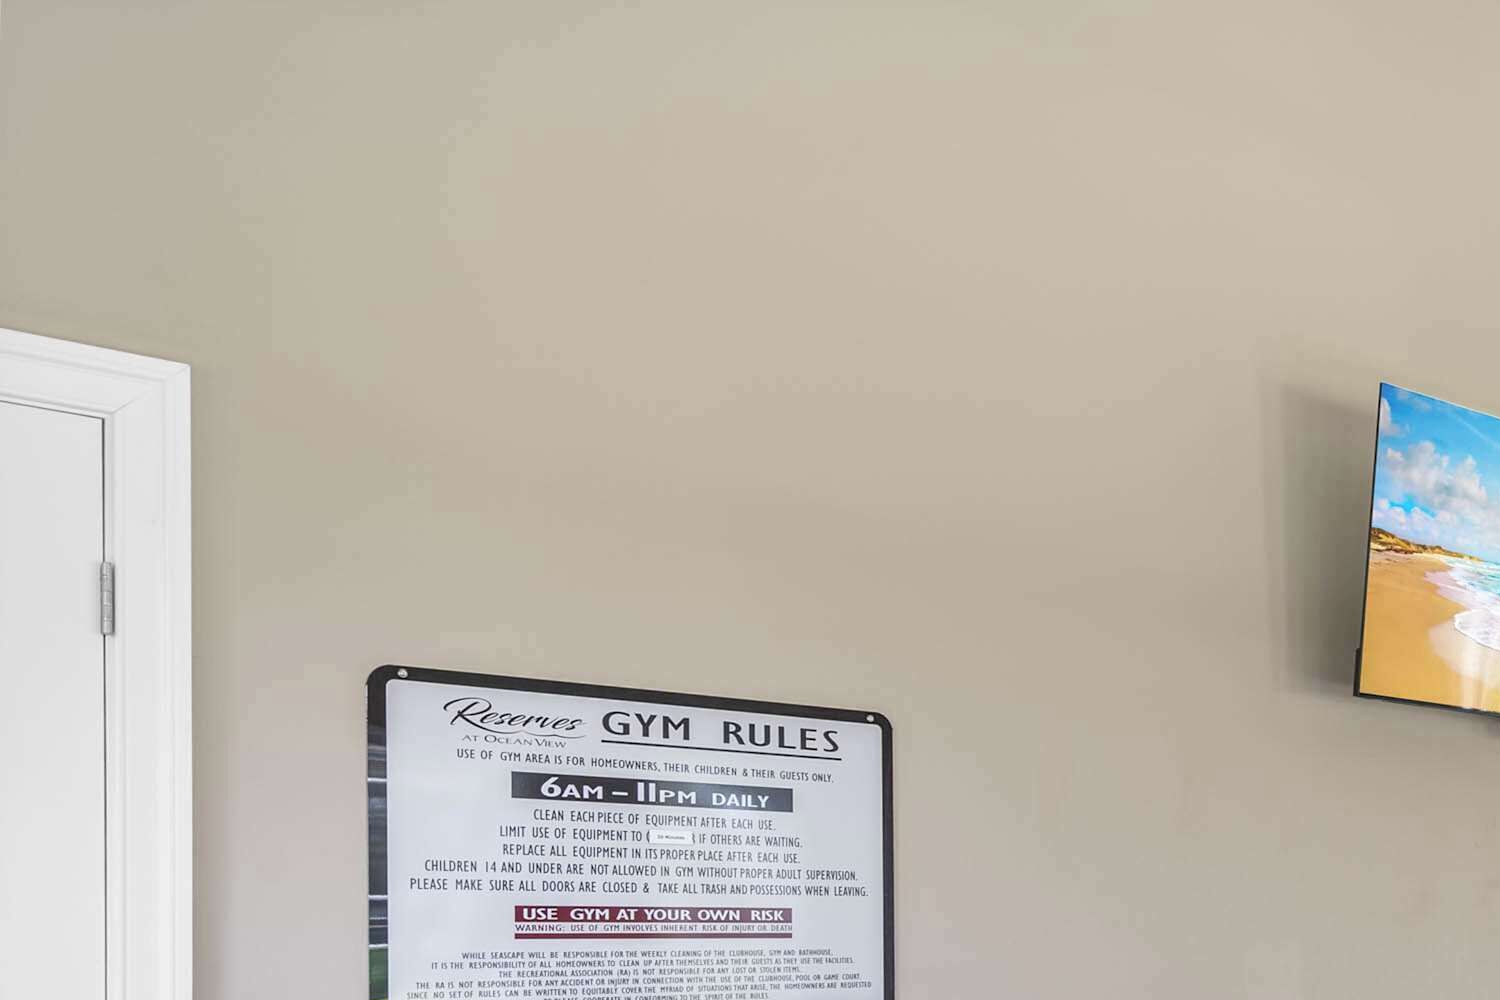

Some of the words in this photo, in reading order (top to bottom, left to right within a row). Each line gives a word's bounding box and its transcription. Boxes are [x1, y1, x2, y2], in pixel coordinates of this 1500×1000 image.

[443, 696, 586, 739] Reserves
[462, 734, 478, 742] AT
[483, 733, 532, 746] OCEAN
[534, 737, 566, 748] VIEW
[602, 709, 689, 741] GYM
[723, 720, 838, 753] RULES
[456, 747, 475, 759] USE
[480, 749, 493, 760] OF
[500, 751, 520, 762] GYM
[524, 752, 550, 764] AREA
[554, 754, 562, 765] IS
[565, 755, 585, 768] FOR
[590, 757, 660, 772] HOMEOWNERS,
[663, 762, 689, 773] THEIR
[694, 764, 736, 776] CHILDREN
[742, 768, 748, 777] &
[751, 768, 775, 779] THEIR
[779, 770, 808, 781] GUESTS
[811, 772, 833, 783] ONLY.
[540, 775, 603, 799] 6AM
[712, 792, 768, 808] DAILY
[533, 808, 564, 821] CLEAN
[570, 810, 595, 823] EACH
[597, 811, 623, 824] PIECE
[627, 812, 639, 825] OF
[645, 813, 697, 828] EQUIPMENT
[700, 816, 726, 828] AFTER
[731, 818, 753, 829] EACH
[758, 819, 775, 830] USE.
[499, 824, 526, 837] LIMIT
[532, 825, 549, 839] USE
[553, 827, 566, 839] OF
[572, 827, 628, 843] EQUIPMENT
[630, 830, 642, 842] TO
[698, 833, 706, 844] IF
[710, 833, 742, 845] OTHERS
[745, 835, 760, 846] ARE
[764, 835, 802, 848] WAITING.
[502, 843, 545, 856] REPLACE
[549, 844, 567, 857] ALL
[572, 845, 628, 860] EQUIPMENT
[631, 847, 641, 859] IN
[644, 847, 657, 859] ITS
[660, 848, 695, 860] PROPER
[697, 849, 723, 861] PLACE
[726, 850, 752, 862] AFTER
[757, 851, 778, 863] EACH
[783, 852, 800, 863] USE.
[424, 859, 477, 872] CHILDREN
[485, 860, 496, 872] 14
[500, 861, 522, 873] AND
[528, 861, 562, 874] UNDER
[566, 863, 584, 875] ARE
[590, 863, 609, 875] NOT
[611, 863, 656, 876] ALLOWED
[660, 865, 670, 876] IN
[675, 865, 693, 877] GYM
[697, 866, 737, 878] WITHOUT
[740, 867, 773, 879] PROPER
[775, 868, 801, 879] ADULT
[806, 869, 857, 881] SUPERVISION.
[410, 877, 448, 890] PLEASE
[455, 878, 482, 891] MAKE
[489, 879, 514, 891] SURE
[518, 879, 536, 892] ALL
[542, 879, 575, 892] DOORS
[578, 880, 596, 892] ARE
[602, 881, 637, 893] CLOSED
[642, 882, 649, 893] &
[657, 882, 678, 893] TAKE
[682, 883, 698, 894] ALL
[700, 883, 726, 894] TRASH
[729, 884, 747, 894] AND
[749, 883, 801, 896] POSSESSIONS
[804, 885, 829, 896] WHEN
[833, 885, 868, 897] LEAVING.
[522, 907, 558, 920] USE
[570, 907, 609, 920] GYM
[616, 908, 638, 920] AT
[644, 908, 691, 920] YOUR
[697, 909, 739, 920] OWN
[751, 909, 783, 921] RISK
[514, 923, 565, 932] WARNING:
[587, 923, 600, 931] OF
[603, 923, 620, 931] GYM
[622, 923, 658, 931] INVOLVES
[431, 961, 438, 969] IT
[440, 961, 447, 969] IS
[450, 961, 464, 969] THE
[468, 960, 525, 969] RESPONSIBILITY
[527, 960, 537, 968] OF
[539, 960, 552, 968] ALL
[555, 959, 605, 968] HOMEOWNERS
[607, 959, 615, 967] TO
[618, 959, 639, 967] CLEAN
[461, 951, 486, 960] WHILE
[490, 951, 524, 959] SEASCAPE
[527, 951, 546, 959] WILL
[563, 950, 607, 959] RESPONSIBLE
[610, 950, 624, 958] FOR
[625, 950, 637, 958] THE
[640, 950, 667, 958] WEEKLY
[498, 970, 512, 978] THE
[516, 969, 568, 978] RECREATIONAL
[569, 968, 613, 977] ASSOCIATION
[616, 968, 631, 977] (RA)
[632, 968, 639, 976] IS
[642, 968, 655, 976] NOT
[415, 981, 430, 990] THE
[435, 981, 445, 989] RA
[447, 981, 454, 989] IS
[458, 980, 473, 988] NOT
[477, 979, 525, 988] RESPONSIBLE
[528, 979, 542, 987] FOR
[544, 979, 558, 987] ANY
[560, 978, 593, 987] ACCIDENT
[594, 977, 605, 986] OR
[607, 977, 629, 986] INJURY
